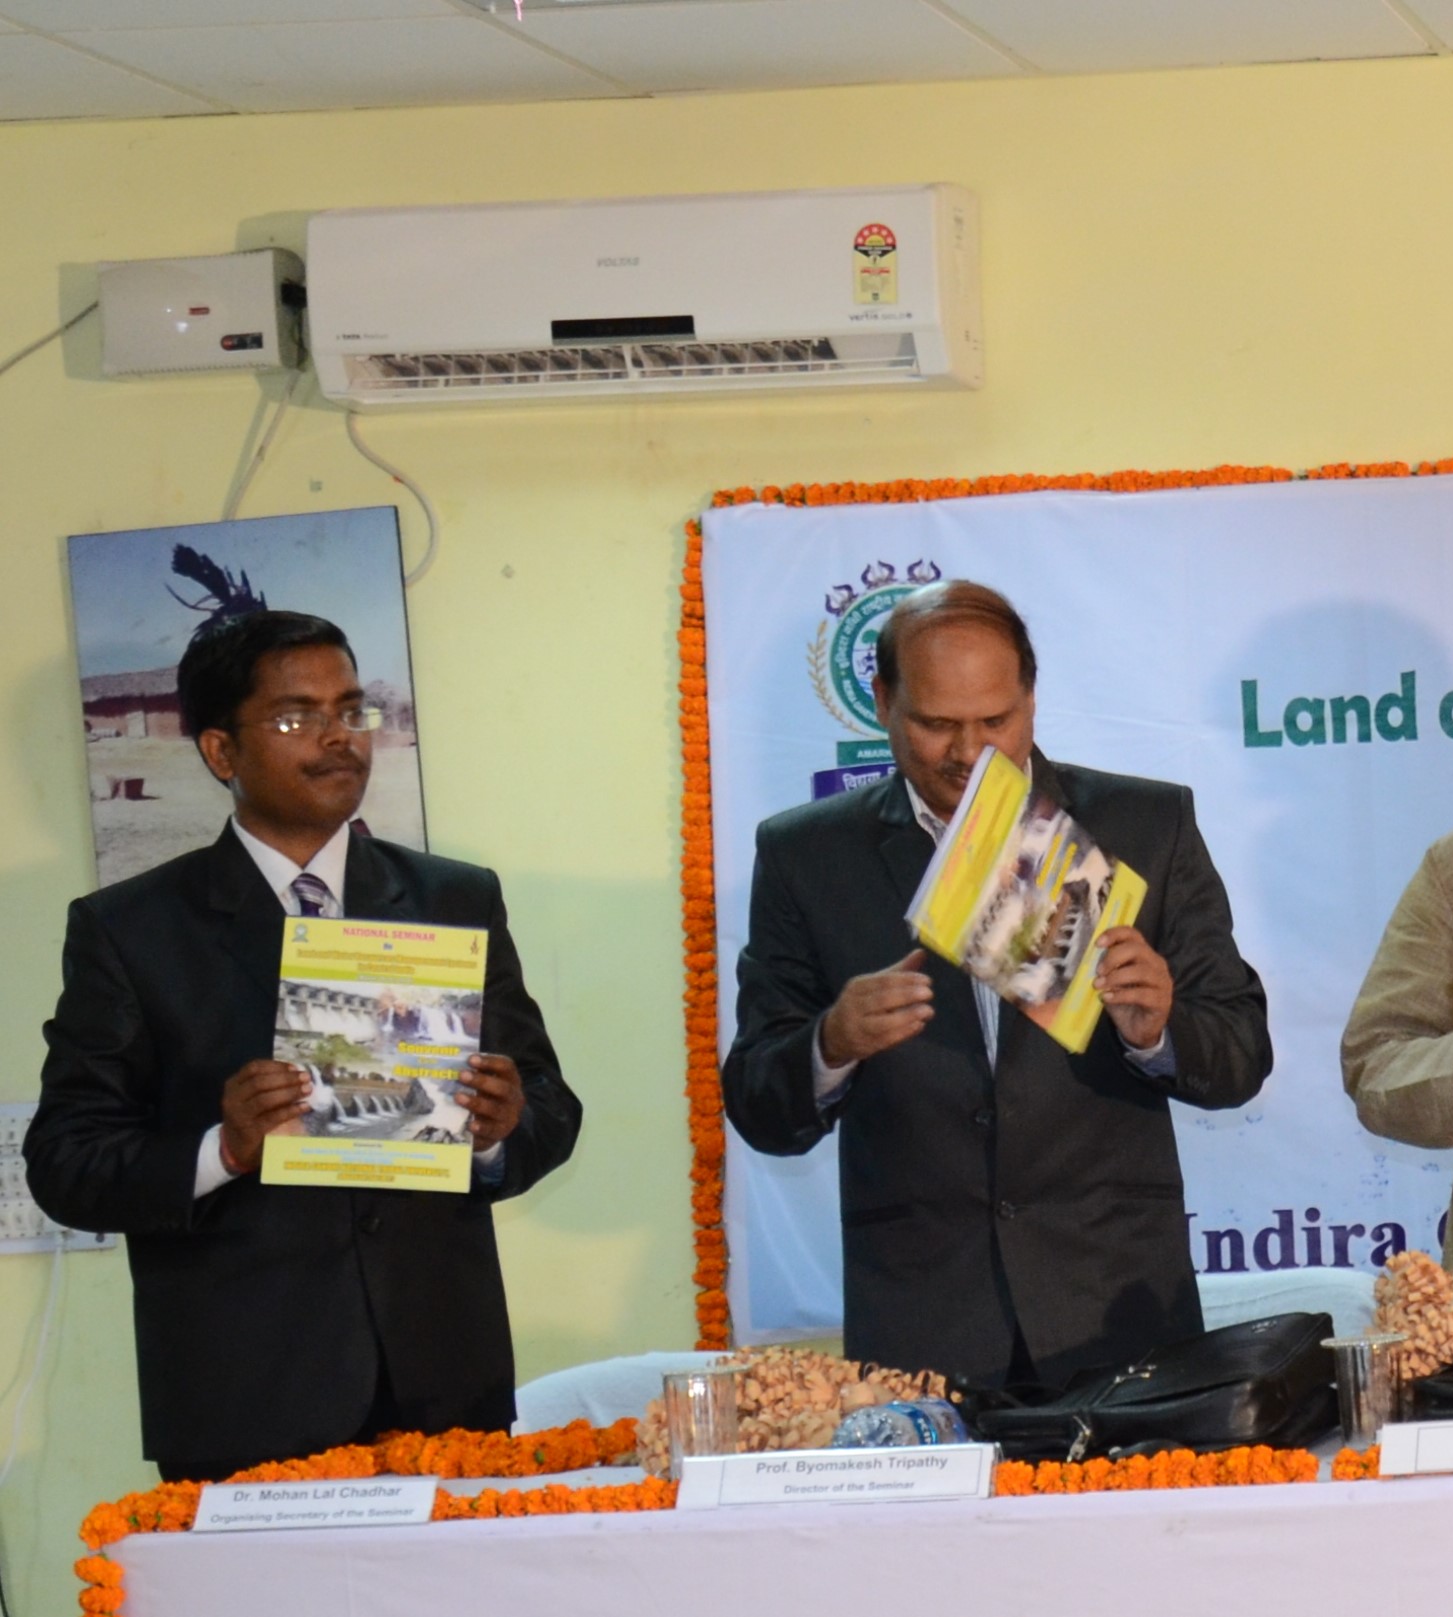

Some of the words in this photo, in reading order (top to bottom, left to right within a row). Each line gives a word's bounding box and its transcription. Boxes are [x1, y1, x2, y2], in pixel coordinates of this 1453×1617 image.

[1241, 670, 1418, 748] Land
[343, 927, 388, 939] NATIONAL
[392, 930, 436, 942] SEMINAR
[756, 1461, 790, 1474] Prof.
[796, 1458, 882, 1475] Byomakesh
[888, 1456, 948, 1470] Tripathy
[233, 1490, 254, 1502] Dr.
[259, 1489, 308, 1501] Mohan
[313, 1487, 335, 1499] Lal
[339, 1485, 402, 1498] Chadhar
[783, 1484, 829, 1495] Director
[832, 1482, 844, 1492] of
[847, 1481, 865, 1491] the
[868, 1480, 915, 1491] Seminar
[210, 1513, 272, 1525] Organising
[276, 1510, 329, 1521] Secretary
[333, 1509, 345, 1519] of
[347, 1509, 364, 1518] the
[367, 1507, 414, 1517] Seminar
